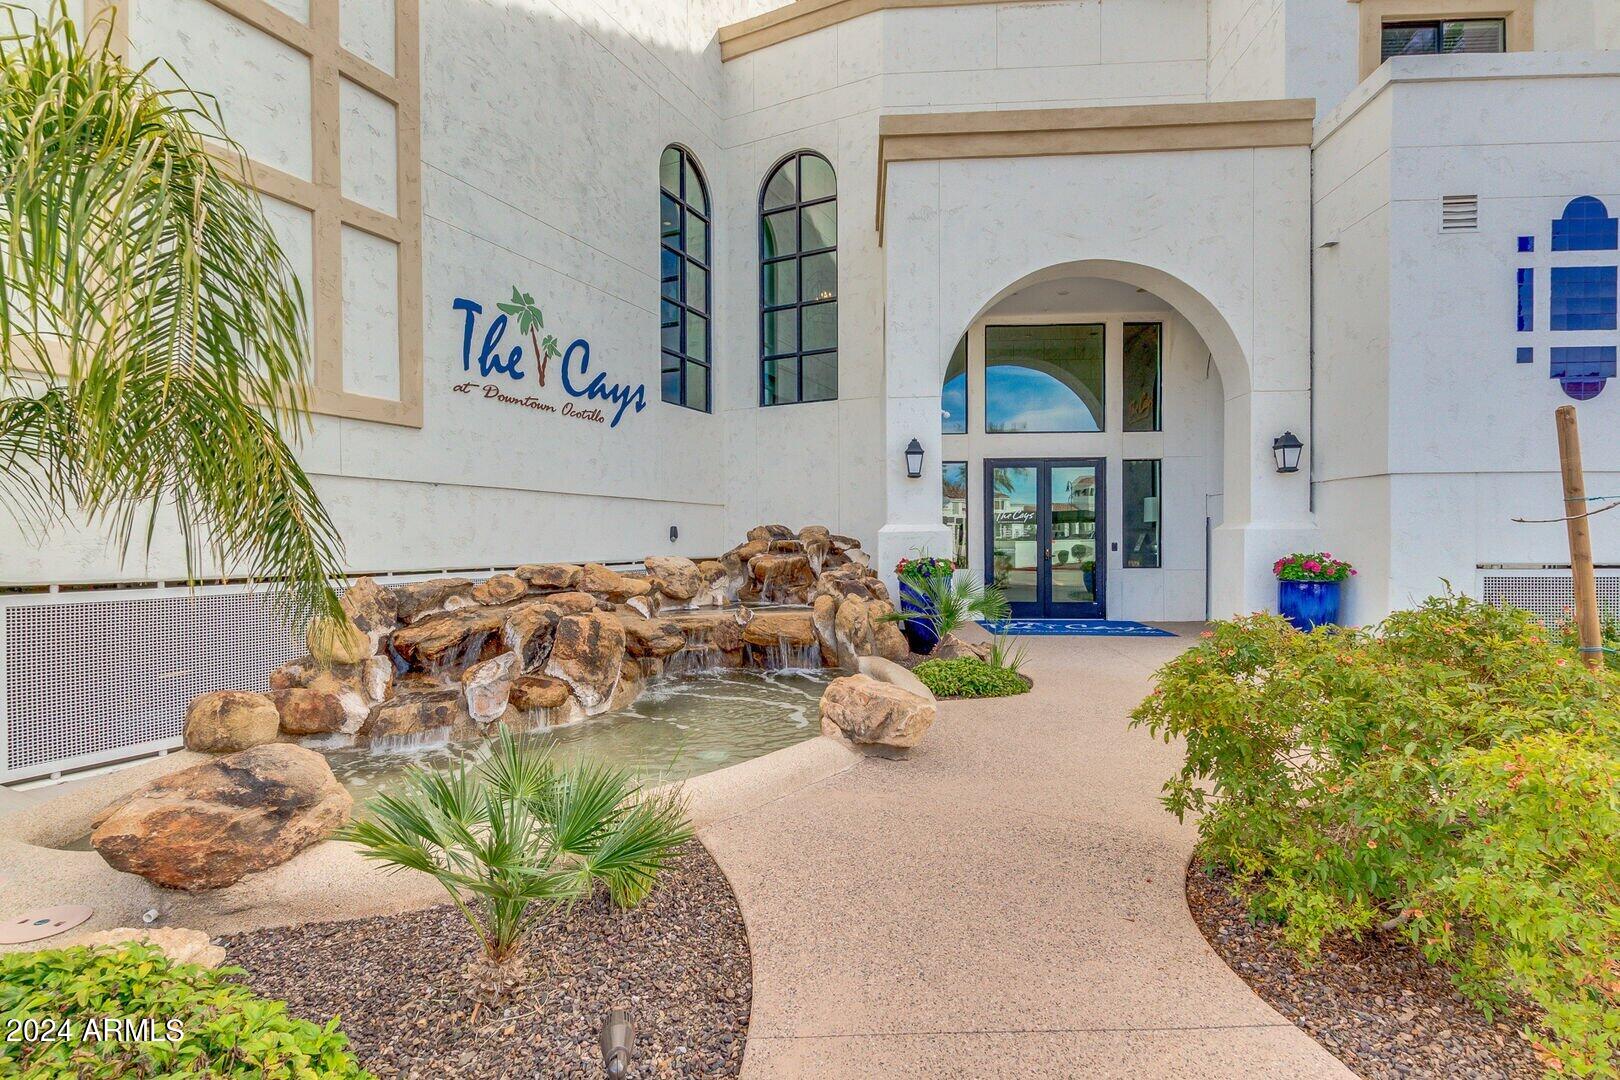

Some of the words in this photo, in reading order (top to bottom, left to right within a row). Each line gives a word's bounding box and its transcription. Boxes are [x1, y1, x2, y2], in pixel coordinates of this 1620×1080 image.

[453, 298, 524, 379] The
[561, 339, 646, 428] Cays
[453, 382, 479, 393] at
[482, 385, 556, 412] Downtown
[561, 403, 605, 423] Ocotillo
[1012, 505, 1034, 523] Cays
